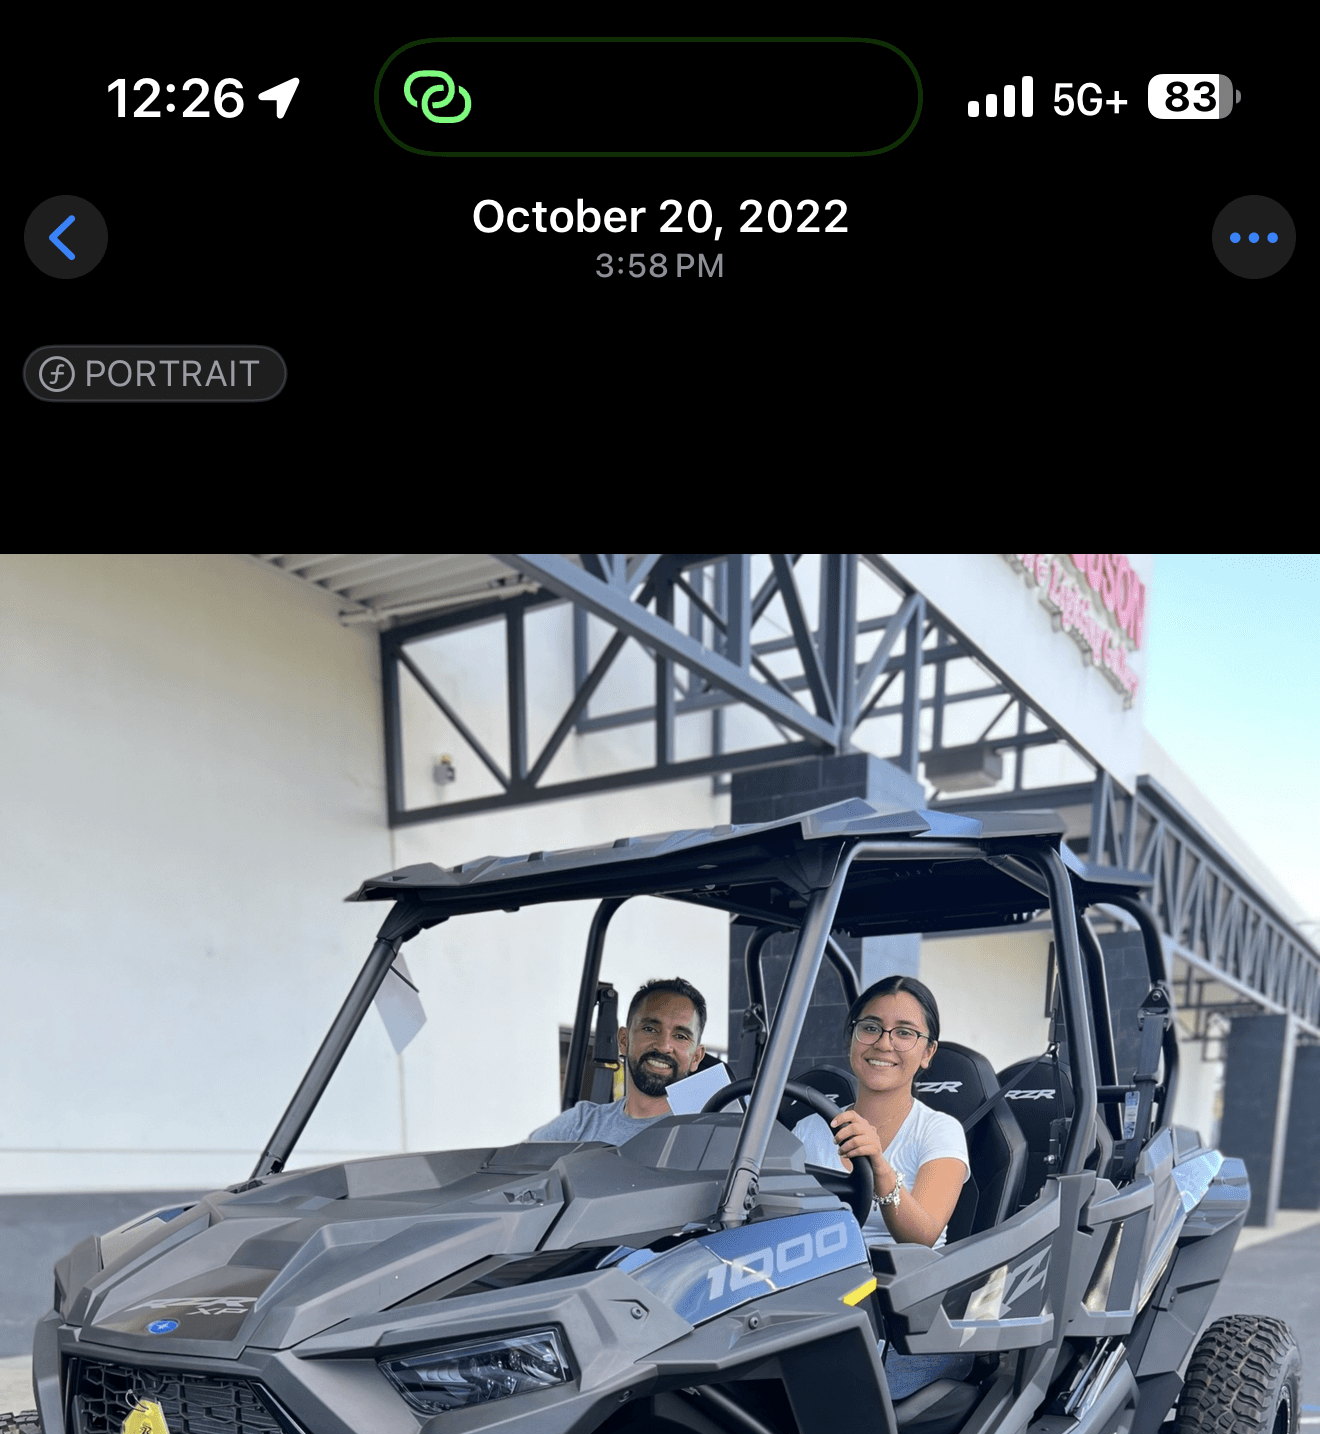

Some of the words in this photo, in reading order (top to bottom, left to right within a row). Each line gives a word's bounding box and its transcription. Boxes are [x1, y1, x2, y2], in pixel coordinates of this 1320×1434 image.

[1066, 554, 1147, 651] USON
[913, 1081, 964, 1094] ZR
[1004, 1089, 1057, 1100] RZR
[707, 1221, 848, 1301] 1000
